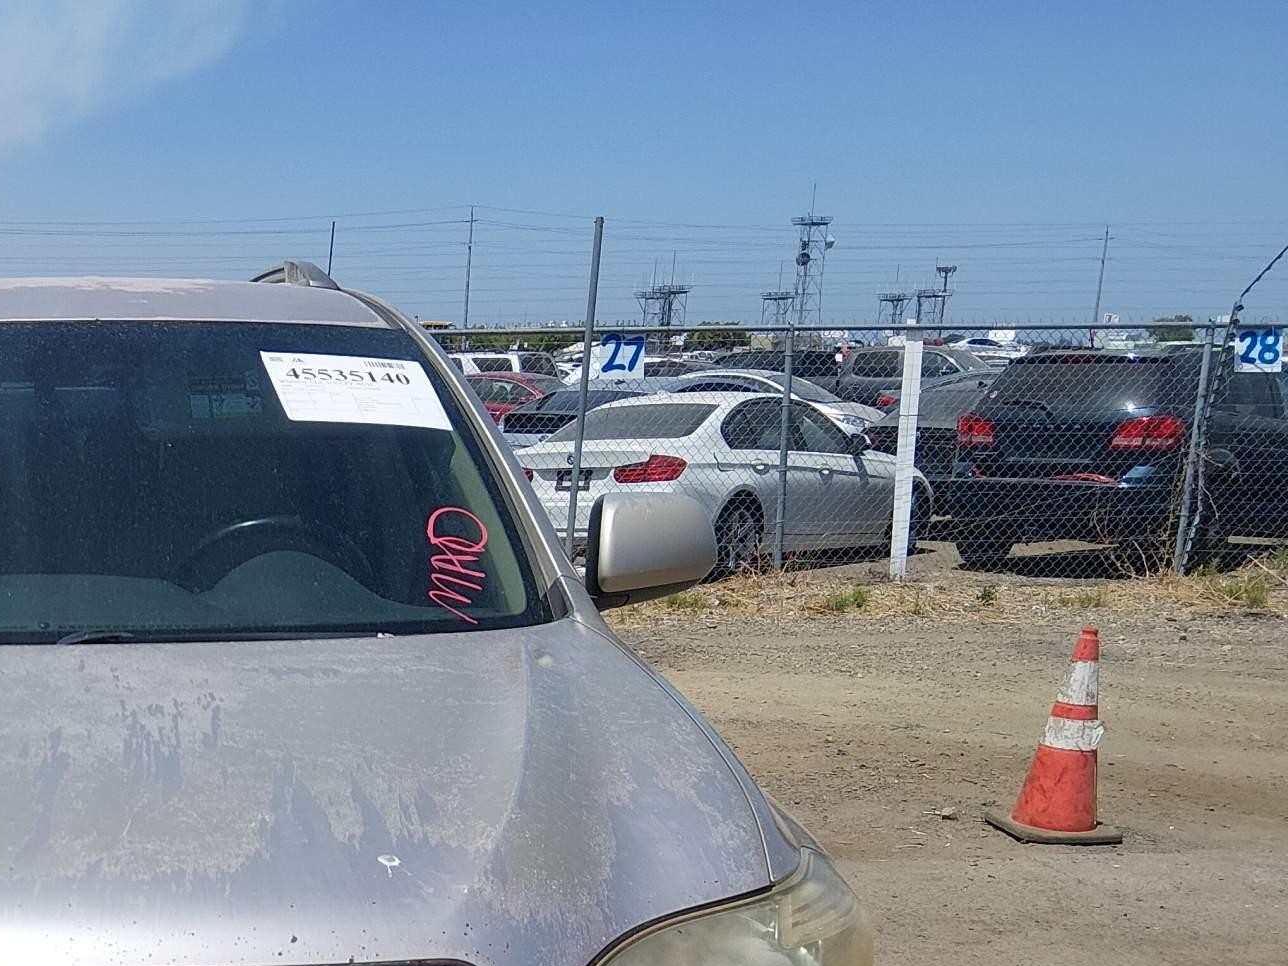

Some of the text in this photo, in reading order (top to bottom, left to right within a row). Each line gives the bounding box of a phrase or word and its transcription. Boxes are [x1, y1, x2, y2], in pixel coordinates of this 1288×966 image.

[601, 333, 645, 373] 27
[1239, 328, 1280, 365] 28
[285, 367, 411, 386] 45535140
